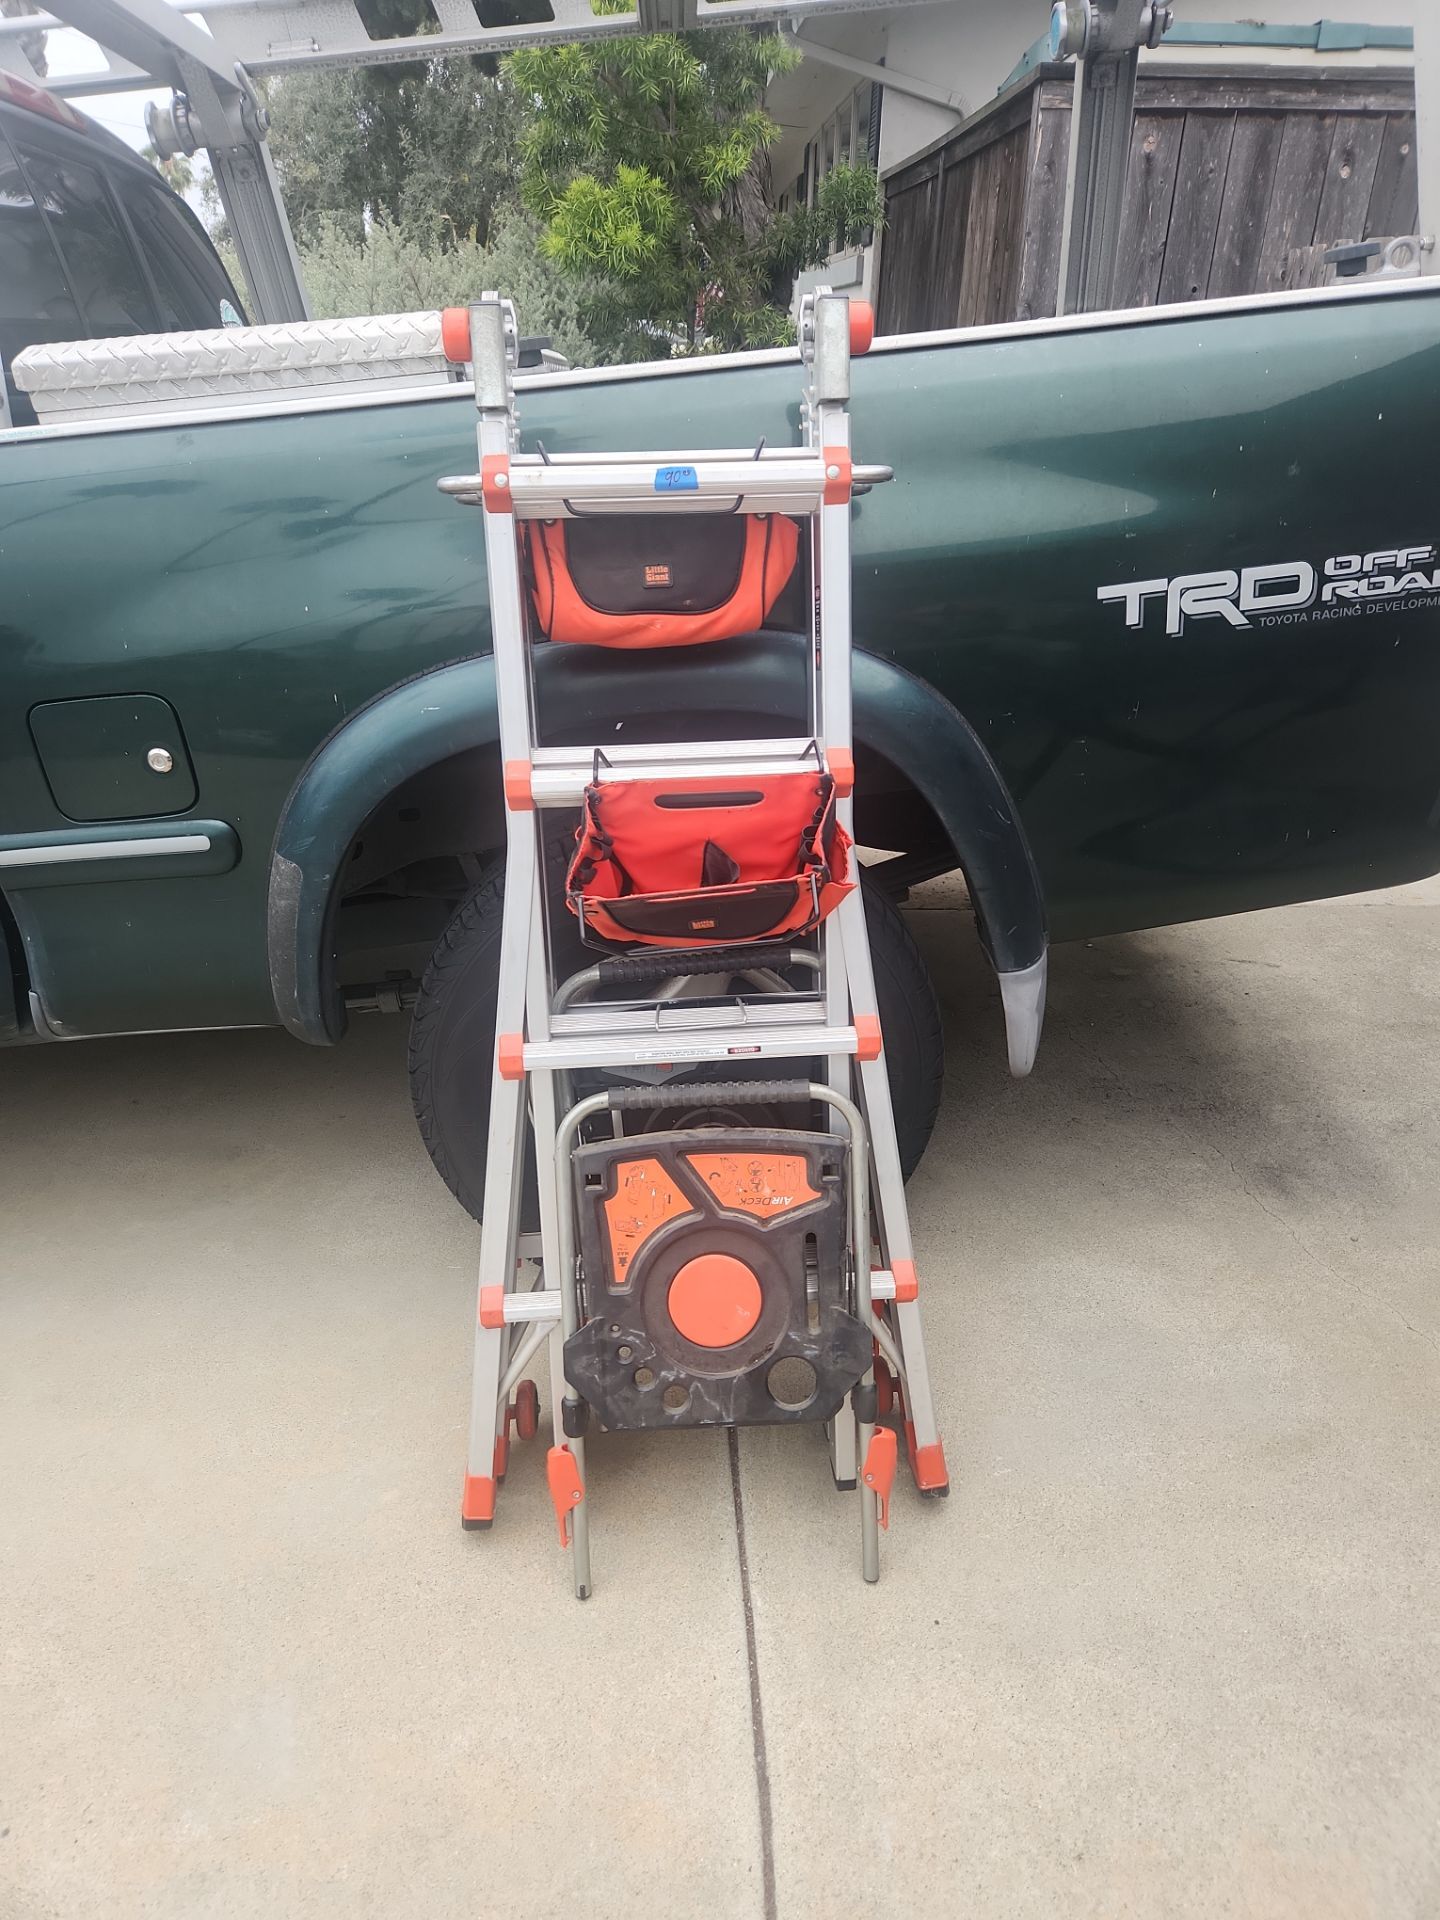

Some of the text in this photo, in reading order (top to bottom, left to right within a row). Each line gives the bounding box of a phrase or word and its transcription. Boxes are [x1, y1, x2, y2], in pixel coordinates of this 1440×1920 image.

[1097, 545, 1437, 637] TRD OFF
[1259, 595, 1440, 628] TOYOTA RACING DEVELOPM
